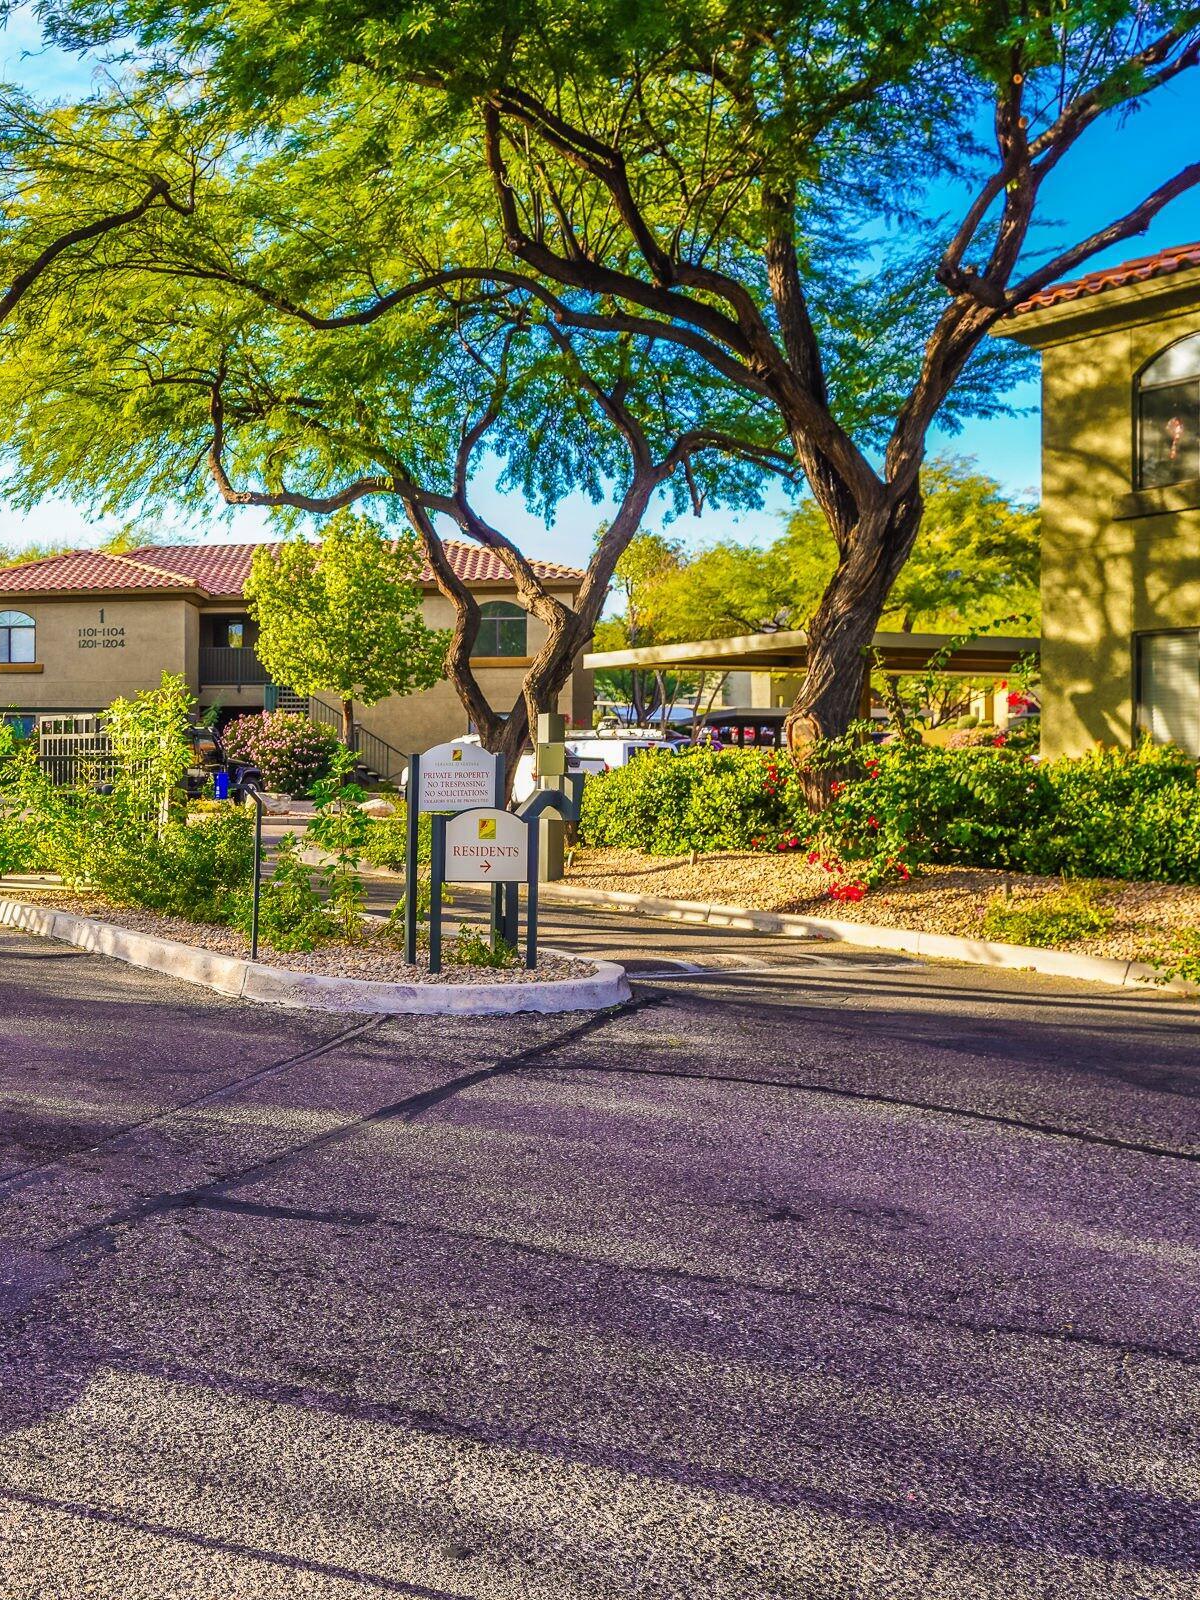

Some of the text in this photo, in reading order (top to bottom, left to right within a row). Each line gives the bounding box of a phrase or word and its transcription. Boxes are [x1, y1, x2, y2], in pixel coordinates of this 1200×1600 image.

[99, 608, 104, 623] 1
[78, 628, 126, 637] 1101-1104
[78, 639, 126, 648] 1201-1204
[423, 771, 490, 779] PRIVATE PROPERTY
[427, 780, 486, 788] NO TRESPASSING
[424, 789, 489, 798] NO SOLICITATIONS
[453, 845, 519, 857] RESIDENTS
